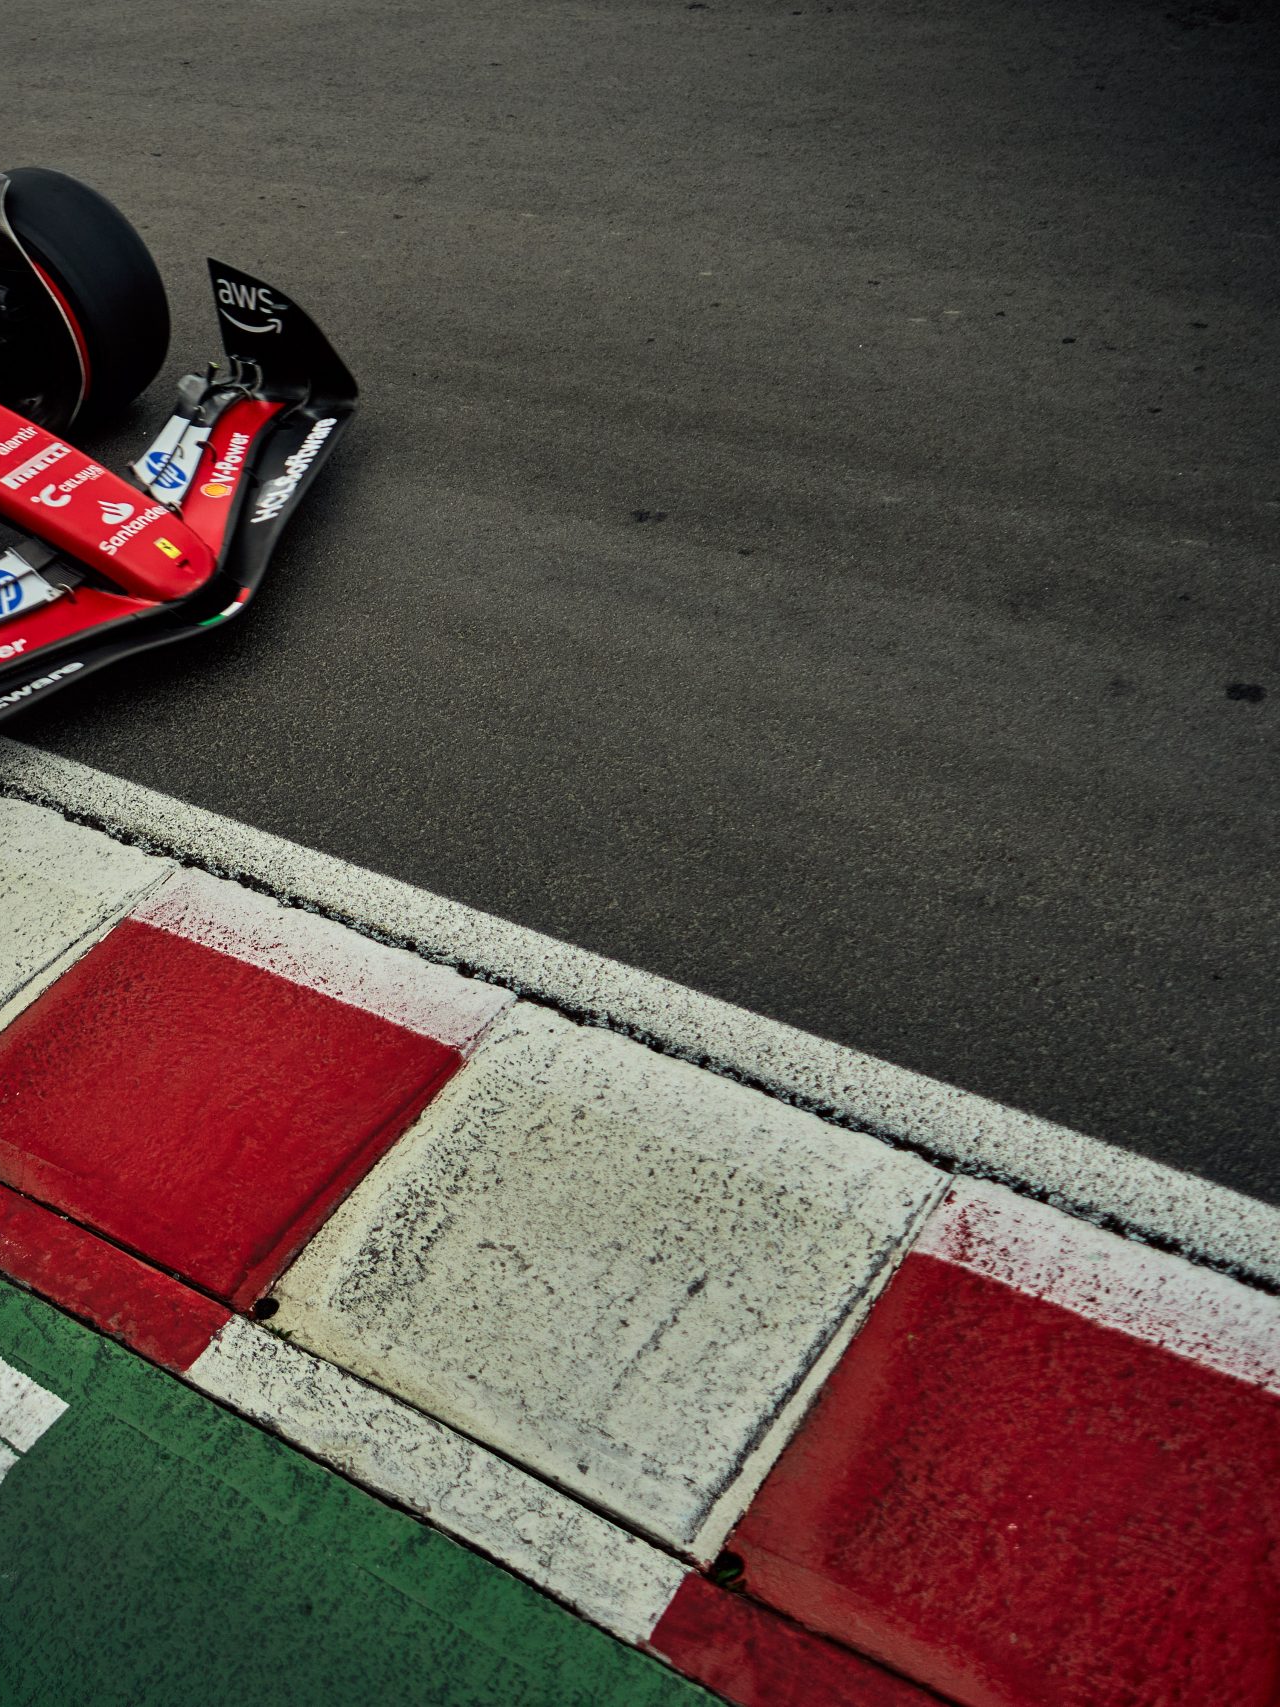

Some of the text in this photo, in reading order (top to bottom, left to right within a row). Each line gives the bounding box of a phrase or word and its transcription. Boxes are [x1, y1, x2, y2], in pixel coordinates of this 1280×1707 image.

[216, 278, 275, 314] aws
[0, 442, 72, 490] PIRELLI
[57, 464, 103, 492] CELSIUS
[146, 453, 187, 489] hp
[210, 432, 250, 483] V-Power
[250, 417, 338, 523] HCLSoftware
[98, 504, 171, 556] Santander
